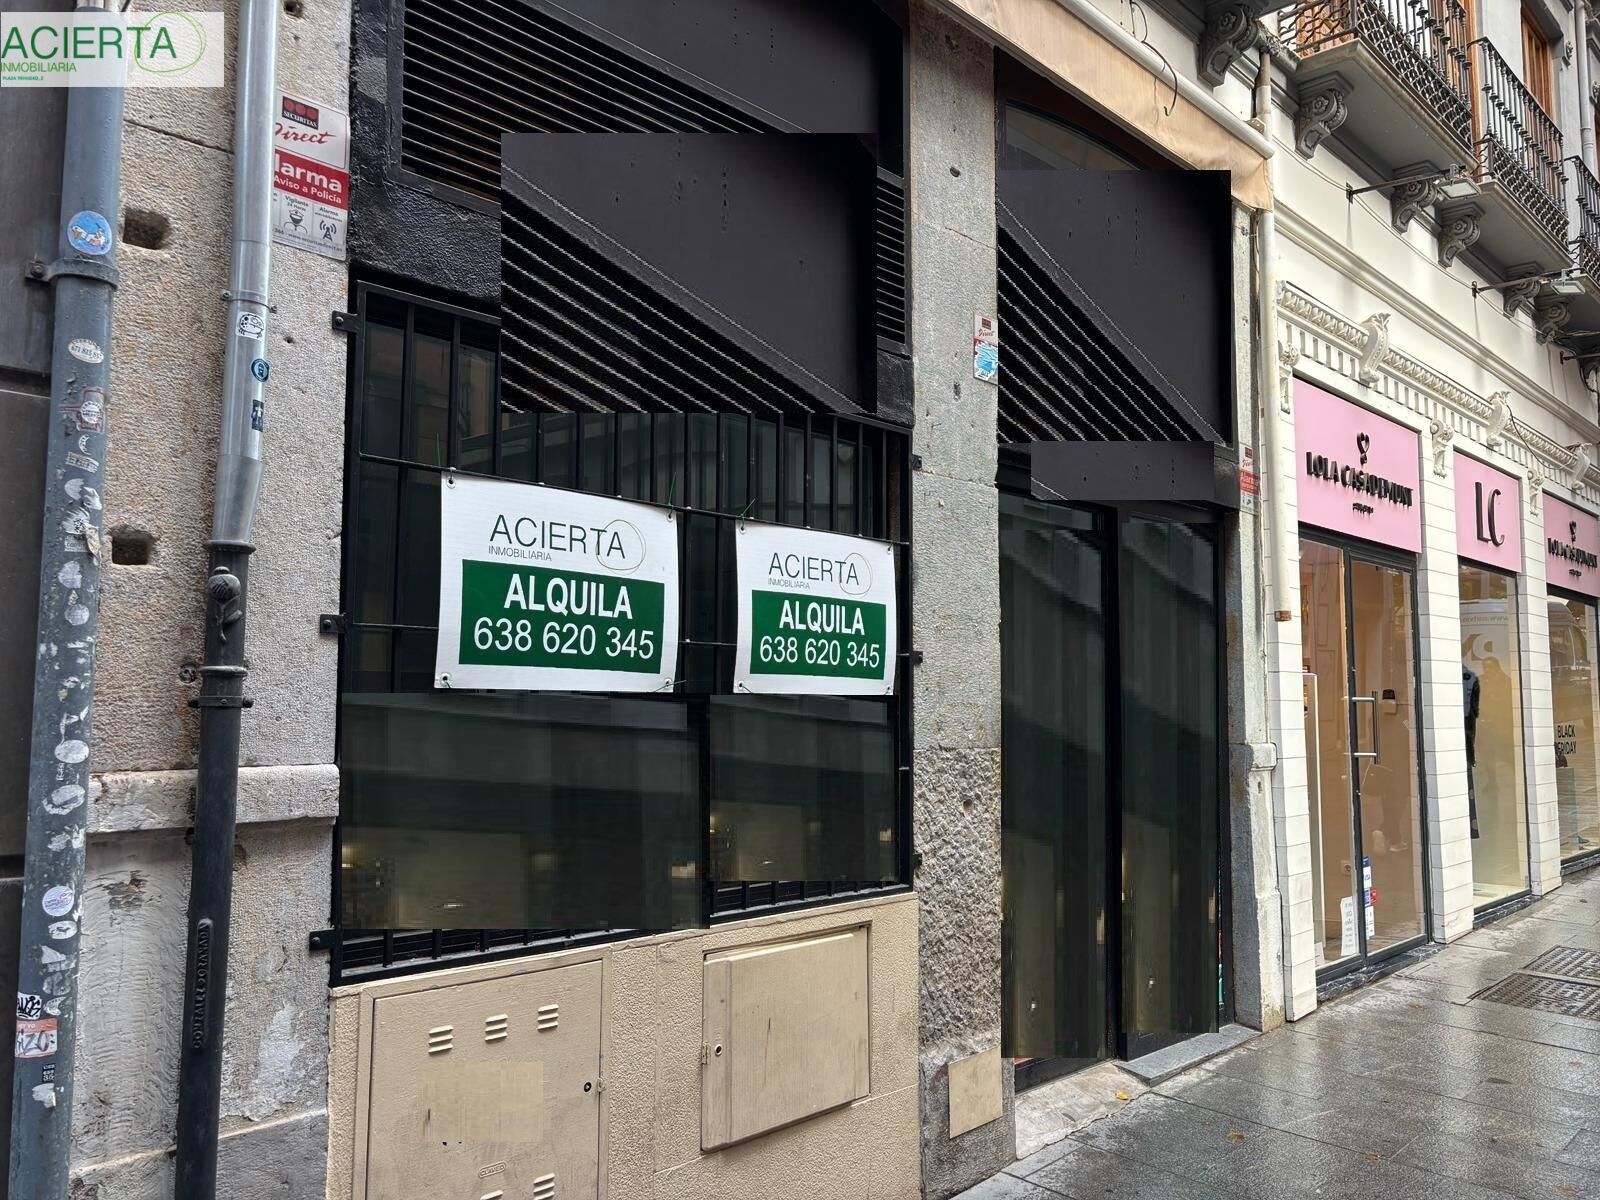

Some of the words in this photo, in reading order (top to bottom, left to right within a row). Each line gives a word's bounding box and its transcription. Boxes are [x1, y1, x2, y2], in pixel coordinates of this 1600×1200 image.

[282, 109, 319, 128] SECURITAS
[274, 153, 342, 193] larma
[310, 186, 342, 204] Policía
[1305, 451, 1340, 484] LOLA
[1475, 481, 1505, 548] LC
[488, 544, 553, 562] INMOBILIARIA
[489, 514, 626, 560] ACIERTA
[767, 577, 811, 590] INMOBILIARIA
[768, 552, 860, 586] ACIERTA
[503, 573, 634, 620] ALQUILA
[779, 599, 866, 636] ALQUILA
[473, 616, 533, 652] 638
[542, 621, 597, 656] 620
[604, 626, 655, 660] 345
[759, 635, 799, 664] 638
[805, 638, 841, 666] 620
[846, 641, 880, 669] 345
[1557, 724, 1577, 738] BLACK
